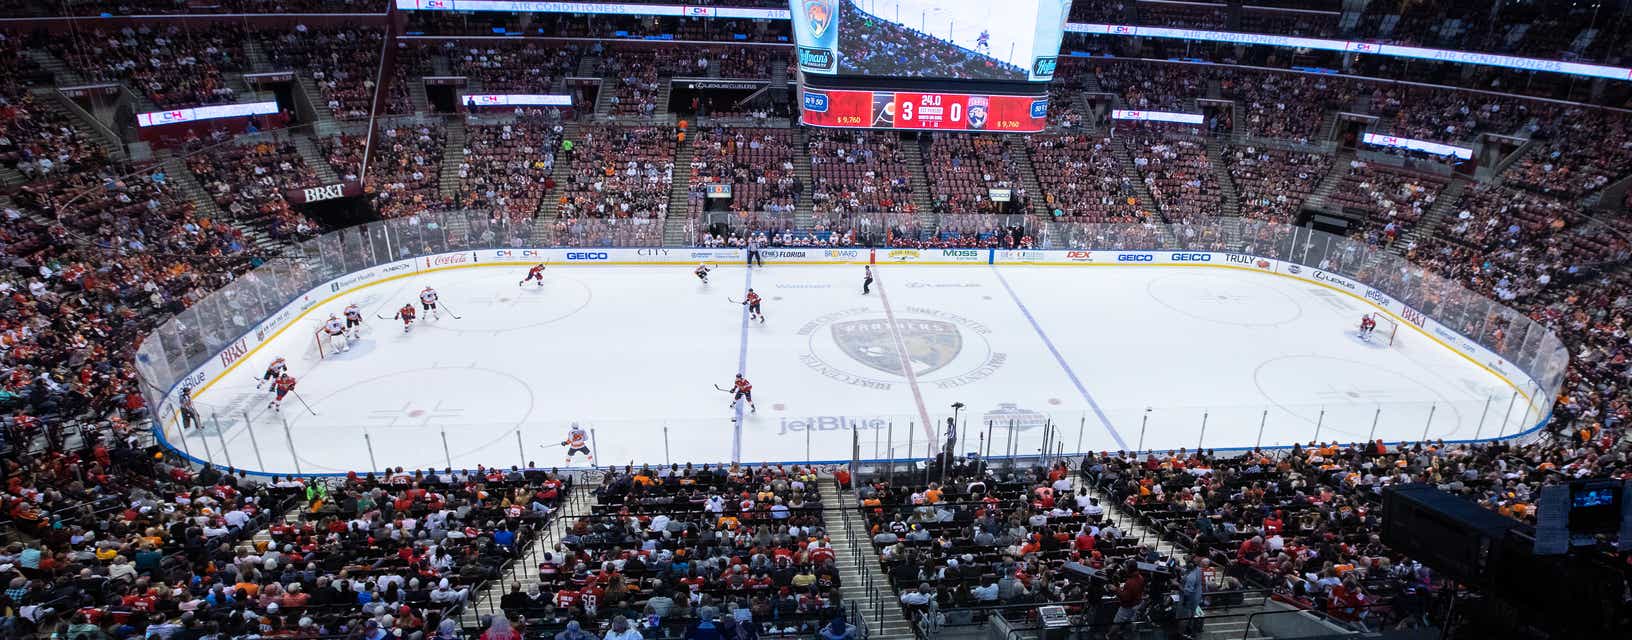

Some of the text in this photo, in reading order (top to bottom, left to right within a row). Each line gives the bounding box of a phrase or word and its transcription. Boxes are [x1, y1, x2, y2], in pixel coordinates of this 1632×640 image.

[512, 3, 625, 13] AIR CONDITIONERS
[768, 10, 786, 18] AIR
[1184, 31, 1289, 44] AIR CONDITIONERS
[1434, 51, 1561, 71] AIR CONDITIONERS
[922, 95, 941, 106] 24.0
[902, 101, 913, 120] 3
[951, 103, 962, 121] 0
[842, 116, 861, 124] 9,760
[304, 183, 345, 203] BB&T
[566, 252, 608, 260] GEICO
[1066, 251, 1091, 259] DEX
[1171, 253, 1212, 262] GEICO
[1225, 253, 1256, 264] TRULY
[220, 338, 248, 369] BB&T
[777, 415, 885, 436] jetBlue
